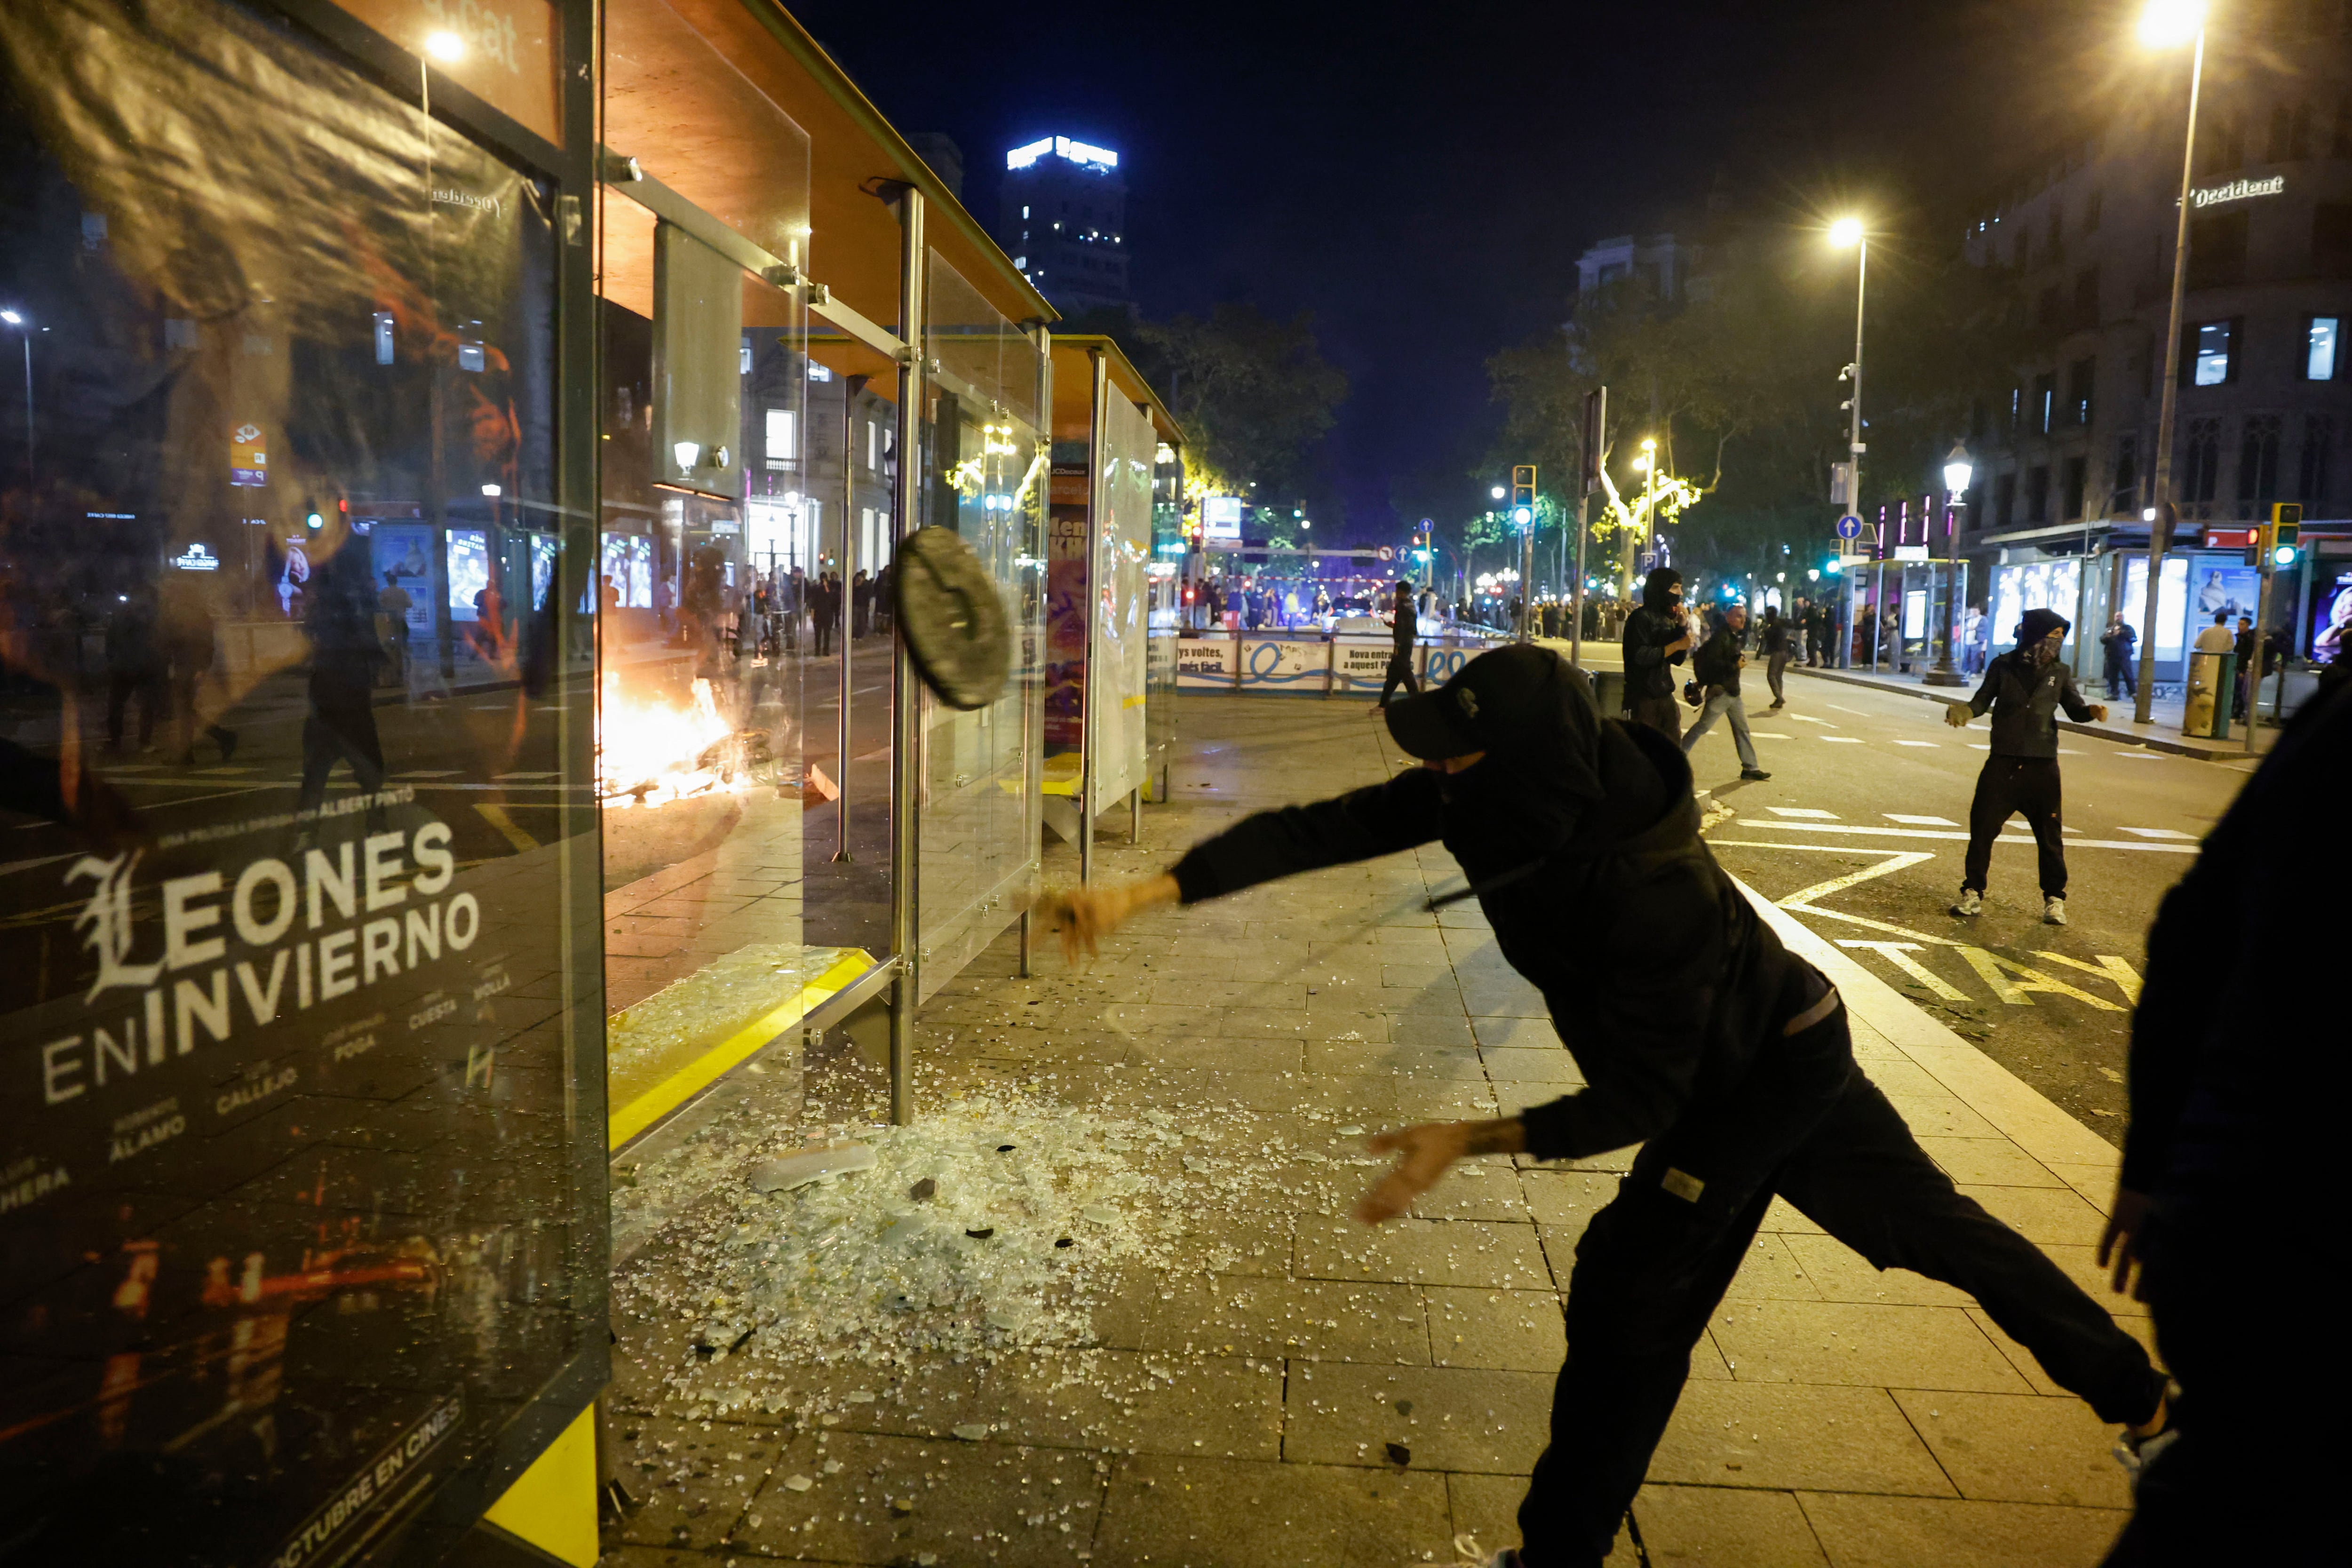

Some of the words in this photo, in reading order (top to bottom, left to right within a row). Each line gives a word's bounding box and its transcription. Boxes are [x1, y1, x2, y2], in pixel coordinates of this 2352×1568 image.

[2196, 175, 2284, 207] Occident
[1644, 556, 1653, 567] P
[1191, 646, 1223, 659] voltes,
[1350, 650, 1369, 659] Nova
[1371, 651, 1394, 659] entra
[1350, 661, 1378, 670] aquest
[319, 794, 373, 818] ALBERT
[64, 821, 454, 1006] LEONES
[1833, 939, 2143, 1012] TAX
[42, 1018, 138, 1105] EN
[145, 892, 479, 1065] INVIERNO
[406, 1397, 462, 1458] CINES
